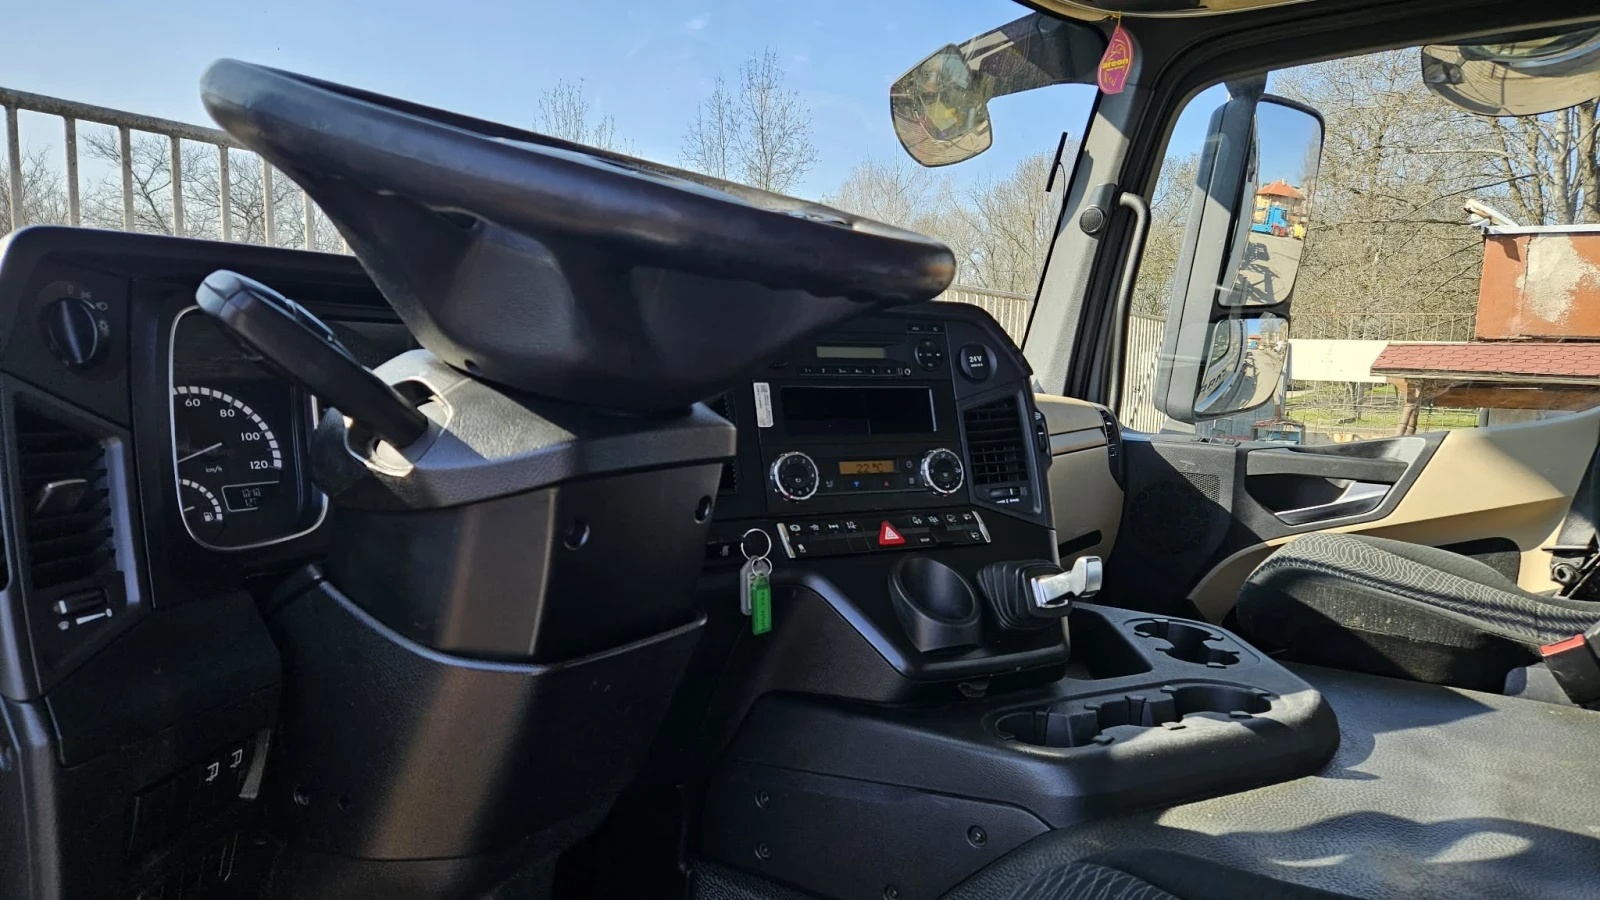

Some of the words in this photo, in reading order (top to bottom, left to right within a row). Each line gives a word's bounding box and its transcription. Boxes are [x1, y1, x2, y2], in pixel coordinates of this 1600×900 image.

[1102, 58, 1129, 69] areon
[969, 355, 982, 363] 24V
[185, 398, 201, 407] 60
[220, 408, 235, 418] 80
[241, 432, 260, 442] 100
[205, 465, 223, 473] km/h
[250, 460, 268, 470] 120
